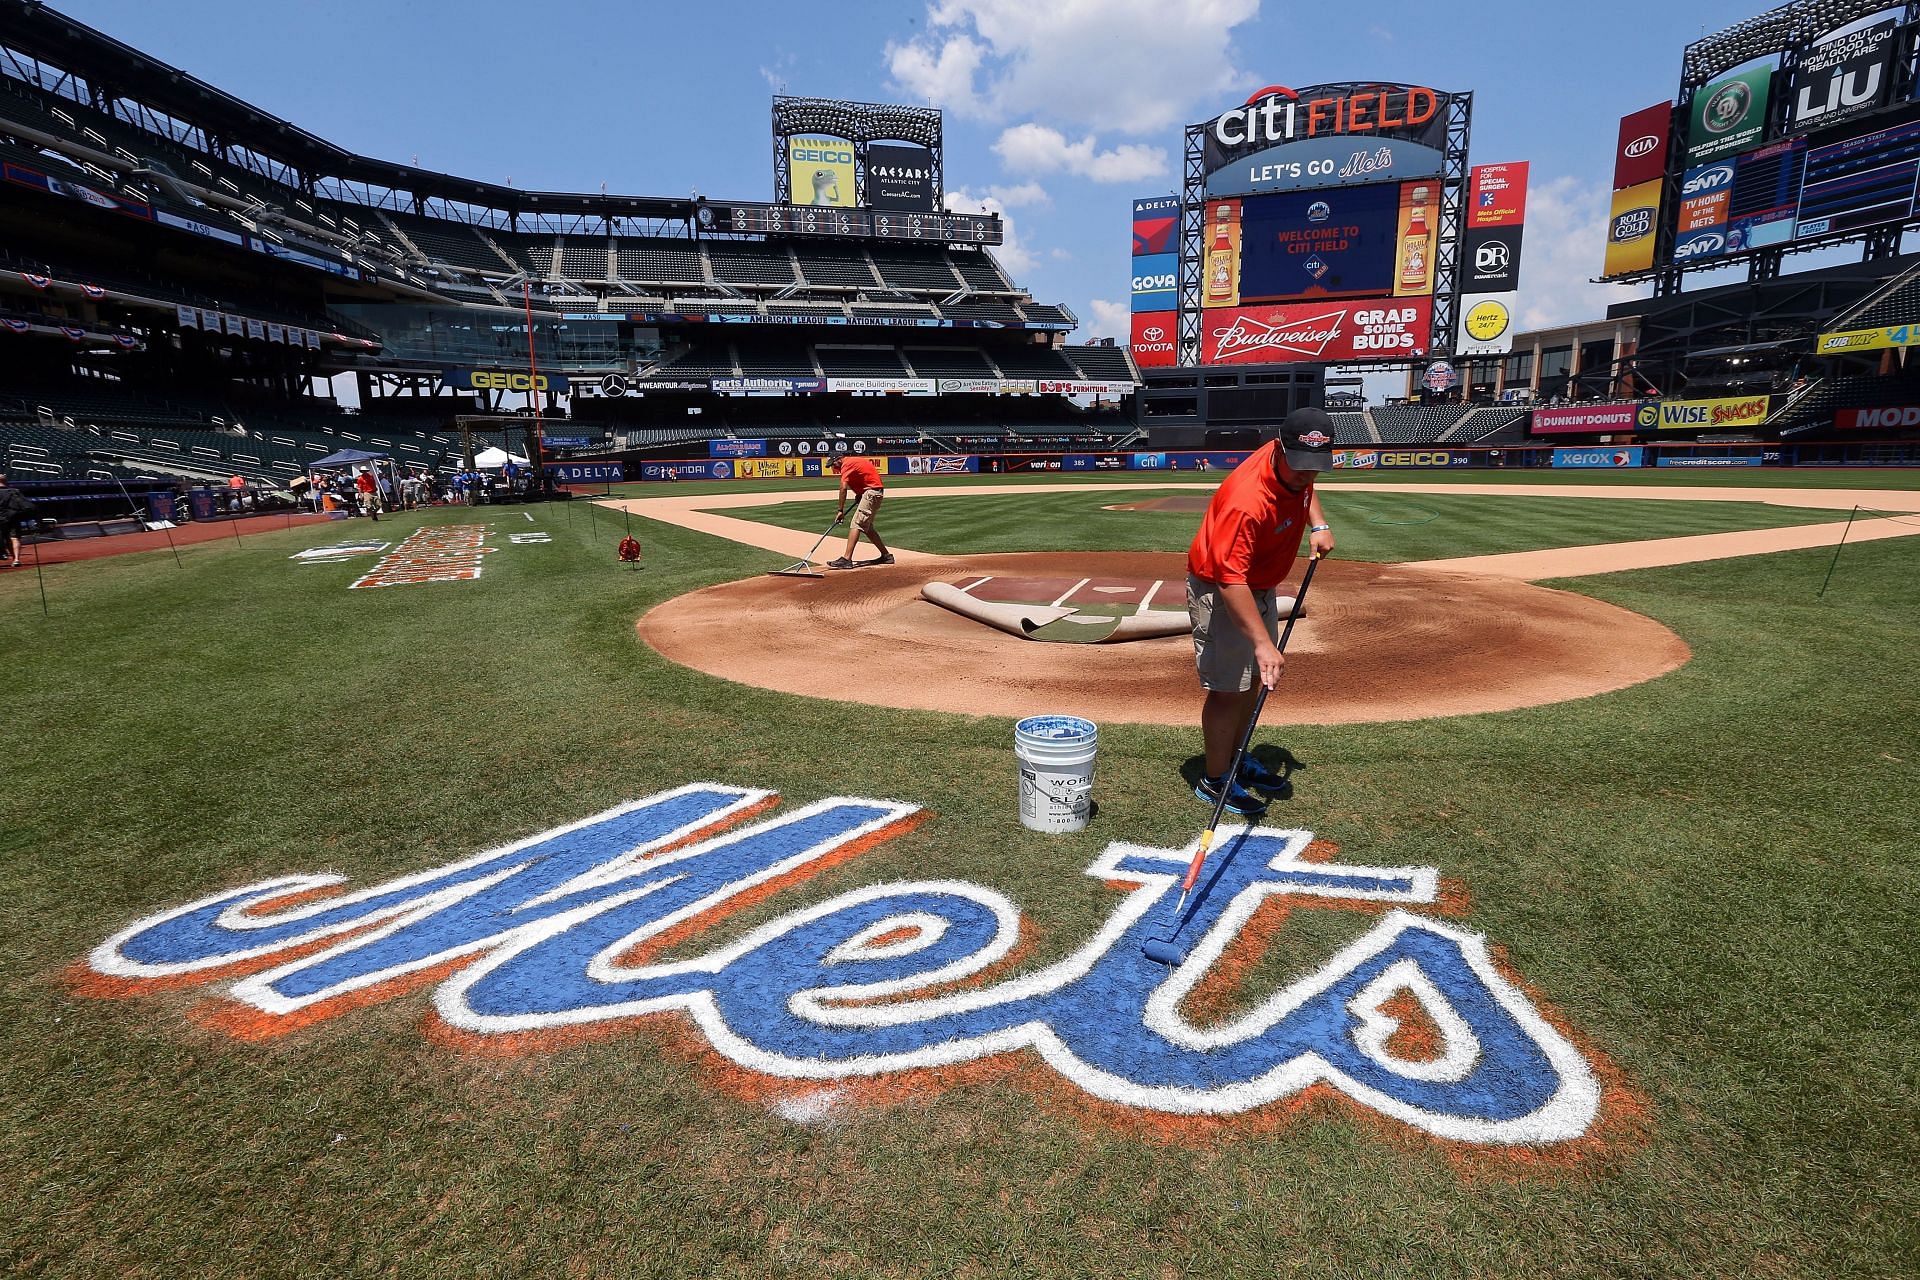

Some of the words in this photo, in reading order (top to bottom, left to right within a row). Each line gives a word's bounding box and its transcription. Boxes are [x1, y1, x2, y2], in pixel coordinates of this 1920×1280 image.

[1819, 40, 1846, 54] FIND
[1849, 27, 1875, 42] OUT
[1800, 54, 1827, 68] HOW
[1829, 41, 1864, 57] GOOD
[1868, 29, 1893, 44] YOU
[1808, 54, 1850, 74] REALLY
[1852, 43, 1879, 59] ARE.
[1216, 95, 1296, 145] citi
[1308, 87, 1437, 136] FIELD
[1794, 119, 1813, 128] LONG
[1814, 112, 1837, 123] ISLAND
[1838, 99, 1877, 116] UNIVERSITY
[1688, 140, 1718, 154] HELPING
[1720, 135, 1735, 144] THE
[1736, 127, 1762, 139] WORLD
[1867, 133, 1886, 143] STATS
[792, 149, 852, 164] GEICO
[1695, 148, 1714, 158] KEEP
[1250, 162, 1301, 182] LET'S
[1307, 159, 1335, 176] GO
[1338, 147, 1392, 178] Mets
[870, 166, 930, 180] CAESARS
[1480, 183, 1510, 191] SURGERY
[1682, 168, 1726, 195] SNY
[881, 189, 921, 200] CaesarsAC.com
[1685, 200, 1697, 210] TV
[1698, 192, 1725, 207] HOME
[1146, 200, 1178, 210] DELTA
[1702, 206, 1714, 215] THE
[1619, 211, 1648, 226] ROLD
[1690, 216, 1715, 229] METS
[1278, 227, 1339, 242] WELCOME
[1343, 226, 1360, 238] TO
[1616, 220, 1649, 238] GOLD
[1287, 242, 1310, 254] CITI
[1314, 240, 1348, 252] FIELD
[1674, 234, 1718, 258] SNY
[1475, 247, 1506, 267] DR
[1306, 260, 1320, 269] citi
[1132, 274, 1176, 291] GOYA
[749, 316, 794, 324] AMERICAN
[797, 316, 828, 324] LEAGUE
[846, 317, 884, 326] NATIONAL
[888, 318, 918, 326] LEAGUE
[1353, 308, 1417, 325] GRAB
[1363, 324, 1405, 334] SOME
[1213, 325, 1341, 349] Budweiser
[1353, 333, 1415, 350] BUDS
[1823, 332, 1879, 350] SUBWAY
[1133, 342, 1174, 353] TOYOTA
[471, 372, 548, 390] GEICO
[639, 382, 678, 390] #WEARYOUR
[712, 379, 742, 388] Parts
[743, 378, 793, 389] Authority
[835, 380, 865, 388] Alliance
[866, 380, 896, 389] Building
[898, 380, 928, 388] Services
[1040, 381, 1072, 393] BOB'S
[1073, 385, 1108, 393] FURNITURE
[1664, 406, 1708, 424] WISE
[1710, 398, 1767, 425] SNACKS
[1543, 414, 1587, 426] DUNKIN'
[1587, 413, 1632, 425] DONUTS
[1141, 456, 1158, 468] citi
[1333, 454, 1344, 464] ulf
[1353, 454, 1376, 466] Gulf
[1380, 452, 1450, 466] GEICO
[1562, 452, 1610, 464] xerox
[1669, 458, 1748, 466] freecreditscore.com
[1763, 452, 1780, 460] 375
[757, 460, 780, 470] Wheat
[1030, 460, 1061, 470] verizon
[572, 467, 621, 478] DELTA
[758, 468, 780, 476] Thins
[89, 782, 1600, 1145] Mets
